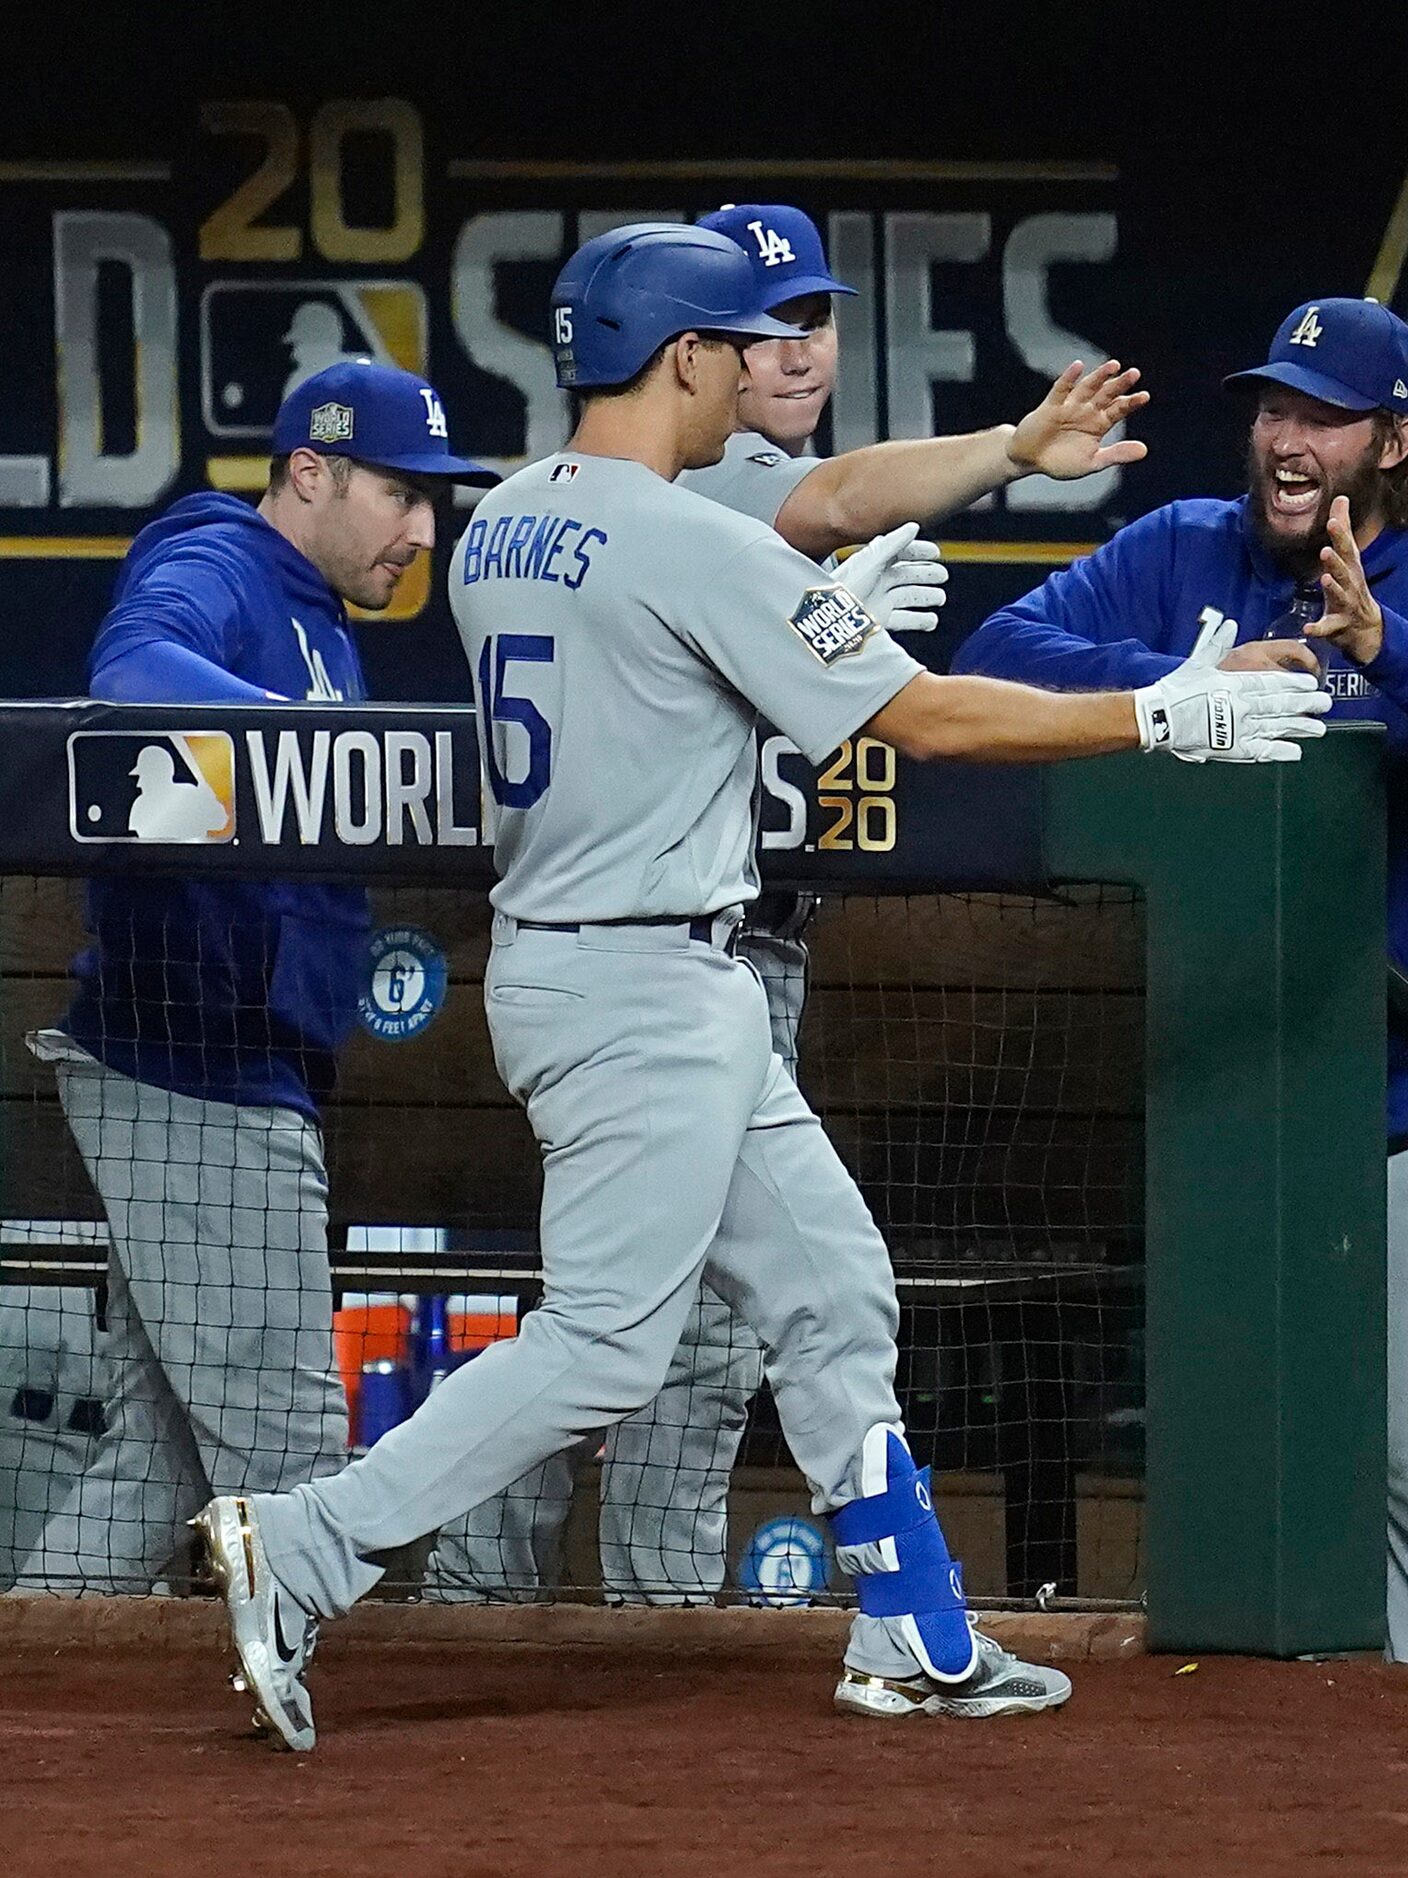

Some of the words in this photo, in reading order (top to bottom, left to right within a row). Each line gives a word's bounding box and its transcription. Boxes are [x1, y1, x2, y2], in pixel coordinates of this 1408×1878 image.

[199, 97, 425, 263] 20
[746, 220, 796, 267] LA
[554, 307, 574, 344] 15
[1288, 306, 1323, 348] LA
[453, 211, 1126, 513] SIES
[312, 422, 350, 436] SERIES
[463, 515, 608, 591] BARNES
[796, 588, 856, 640] WORLD
[811, 606, 871, 658] SERIES
[478, 633, 555, 810] 15
[246, 730, 494, 847] WORL
[817, 796, 896, 852] 20
[381, 1020, 406, 1035] FEET
